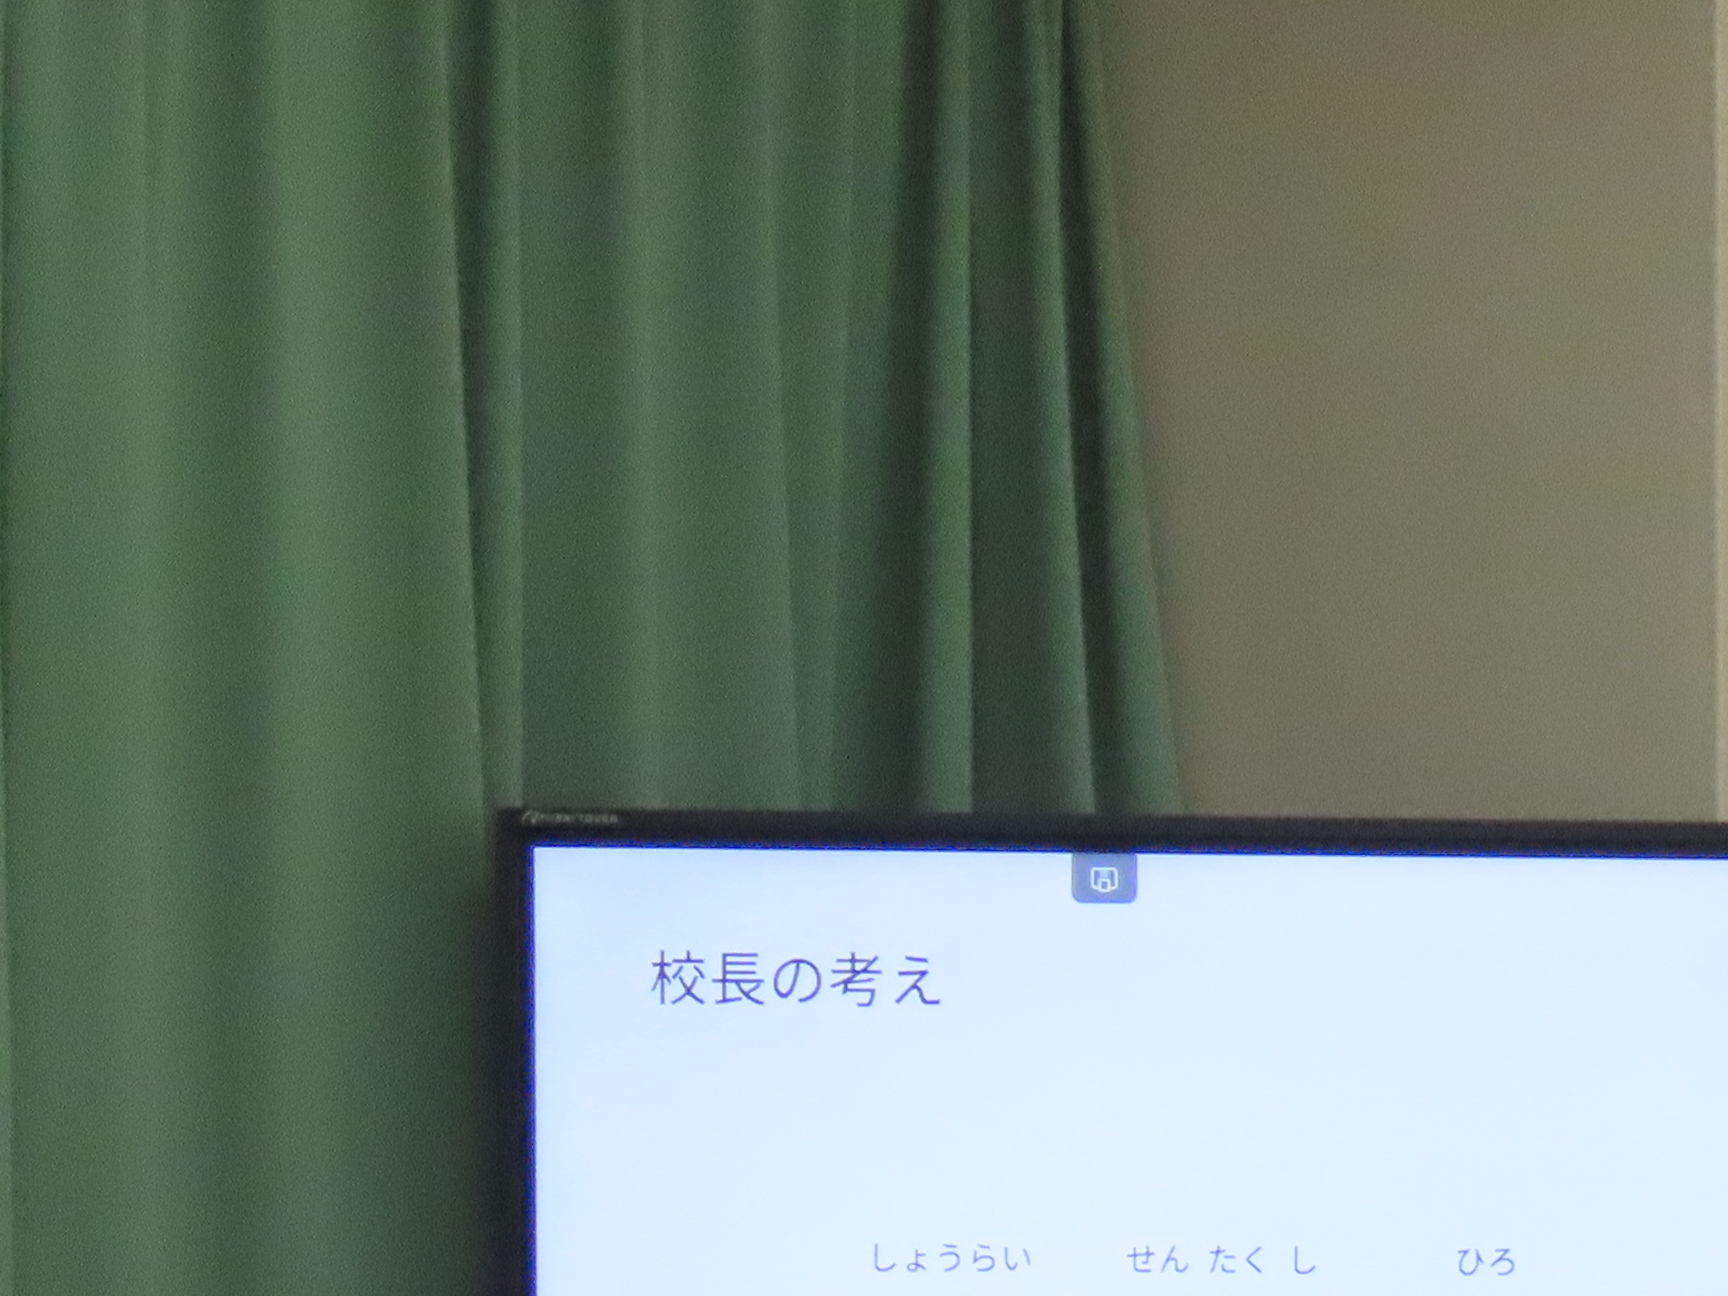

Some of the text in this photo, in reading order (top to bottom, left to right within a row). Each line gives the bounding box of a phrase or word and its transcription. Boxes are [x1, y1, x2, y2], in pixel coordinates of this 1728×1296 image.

[650, 949, 942, 1009] 校長の考え
[874, 1243, 1031, 1273] しょうらい
[1458, 1248, 1515, 1276] ひろ
